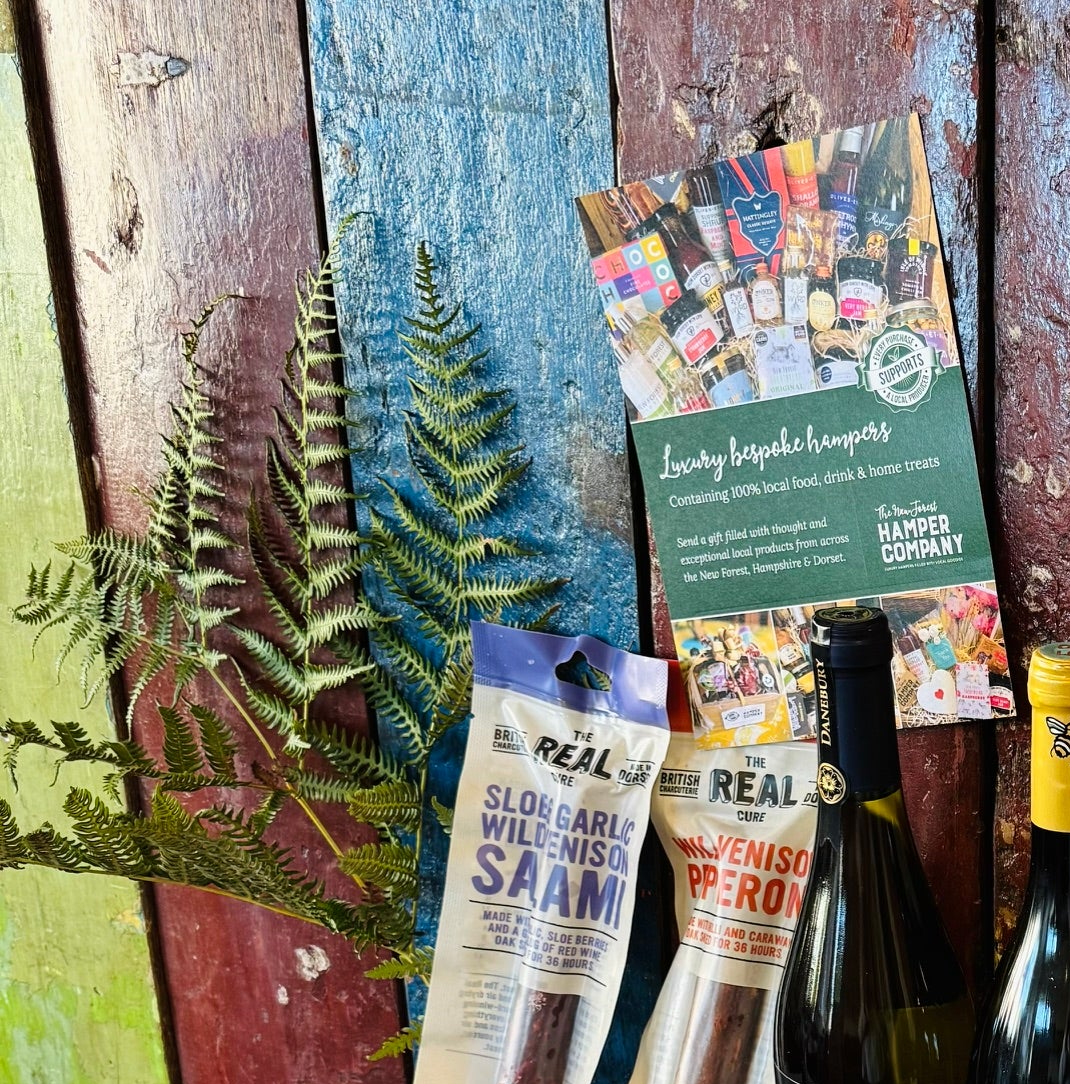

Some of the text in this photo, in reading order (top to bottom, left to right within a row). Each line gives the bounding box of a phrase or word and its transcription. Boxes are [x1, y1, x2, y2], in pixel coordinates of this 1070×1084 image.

[878, 353, 925, 385] SUPPORTS
[660, 421, 892, 482] Luxury bespoke hampers
[669, 456, 941, 509] Containing 100% local food, drink & home treats
[676, 534, 700, 550] Send
[708, 529, 724, 548] gift
[725, 526, 748, 543] filled
[749, 524, 771, 539] with
[772, 519, 808, 540] thought
[809, 516, 828, 530] and
[877, 514, 951, 543] HAMPER
[881, 533, 964, 565] COMPANY
[684, 552, 846, 583] the New Forest, Hampshire & Dorset.
[815, 657, 832, 747] DANEBURY
[531, 735, 612, 781] REAL
[745, 755, 767, 769] THE
[660, 771, 701, 787] BRITISH
[709, 768, 799, 809] REAL
[736, 810, 767, 823] CURE
[734, 942, 748, 953] 36
